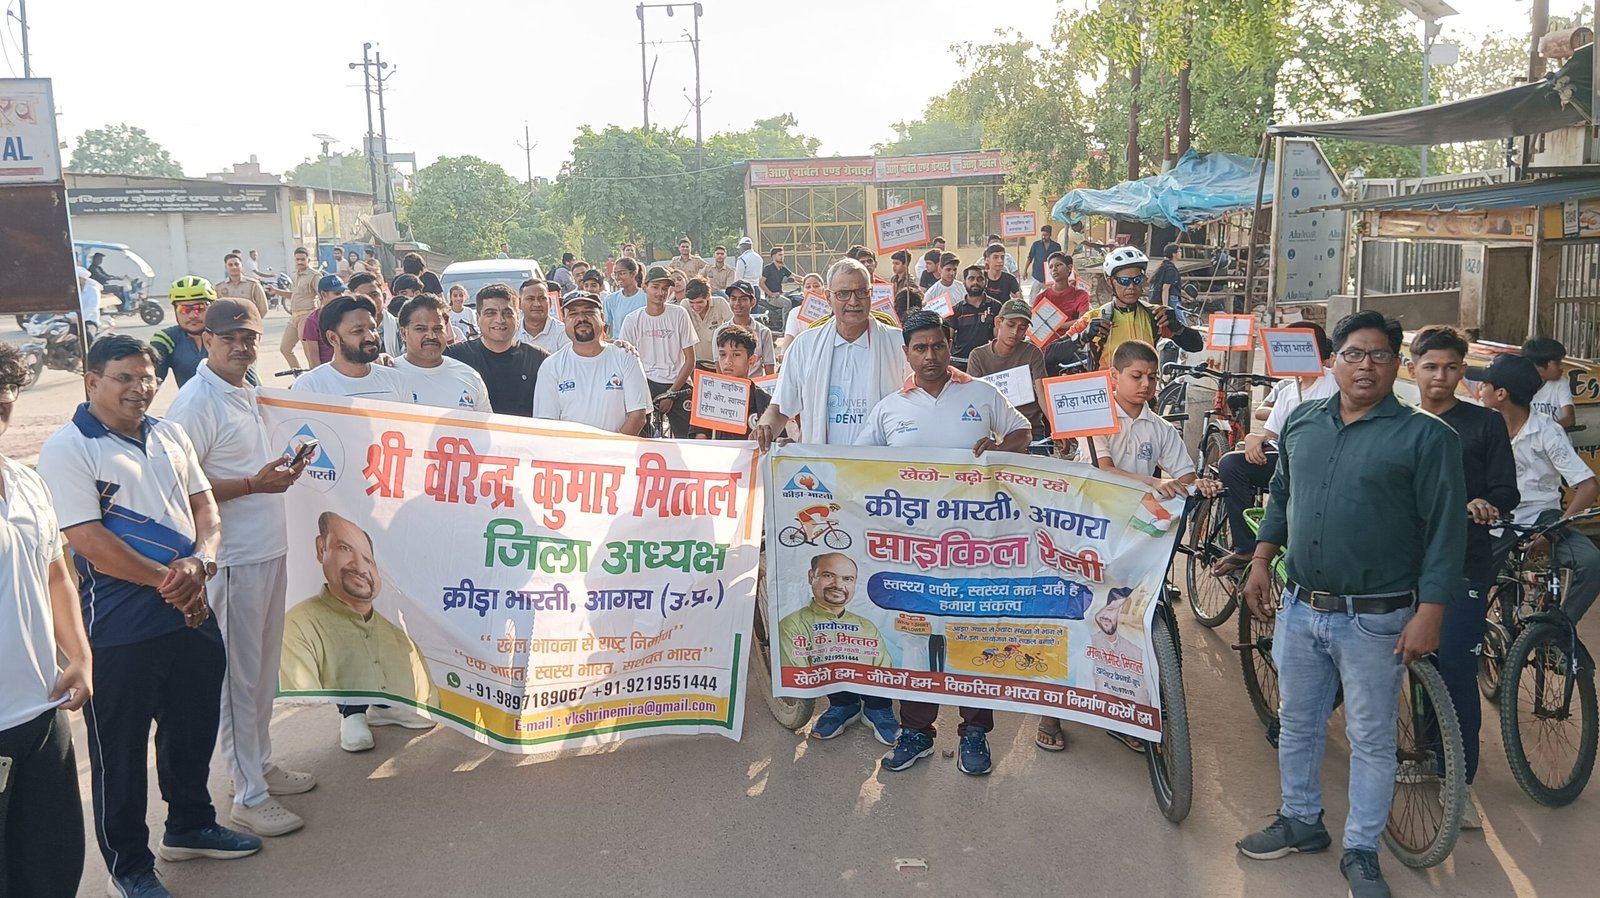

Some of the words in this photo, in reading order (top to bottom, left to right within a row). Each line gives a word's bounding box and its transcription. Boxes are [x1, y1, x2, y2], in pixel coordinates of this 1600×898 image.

[1271, 341, 1292, 354] क्रीड़ा
[1292, 341, 1314, 353] भारती
[703, 390, 712, 400] की
[1056, 394, 1079, 409] क्रीड़ा
[1080, 389, 1107, 405] भारती
[701, 403, 716, 413] रहेगा
[361, 430, 412, 499] श्री
[531, 459, 626, 530] कुमार
[632, 452, 742, 519] मित्तल
[994, 470, 1039, 488] स्वस्थ
[1042, 479, 1069, 493] रहो
[864, 488, 930, 526] क्रीड़ा
[936, 491, 1020, 521] भारती,
[1028, 505, 1111, 540] आगरा
[483, 517, 592, 574] जिला
[601, 539, 731, 575] अध्यक्ष
[866, 529, 1029, 570] साइकिल
[1035, 529, 1104, 583] रैली
[443, 578, 500, 617] क्रीड़ा
[505, 582, 576, 613] भारती,
[584, 588, 653, 611] आगरा
[939, 599, 976, 612] हमारा
[979, 598, 1022, 613] संकल्प
[812, 621, 859, 632] आयोजक
[497, 636, 528, 654] खेल
[530, 637, 577, 653] भावना
[581, 632, 594, 650] से
[599, 634, 627, 655] राष्ट्र
[836, 631, 879, 648] मित्तल
[535, 664, 575, 680] स्वस्थ
[466, 683, 587, 710] +91-9897189067
[592, 674, 718, 697] +91-9219551444
[944, 675, 1001, 697] विकसित
[1004, 682, 1040, 700] भारत
[1043, 690, 1064, 705] का
[1066, 690, 1106, 712] निर्माण
[1137, 708, 1153, 726] हम
[514, 717, 553, 732] E-mail
[564, 698, 716, 725] vkshrinemira@gmail.com
